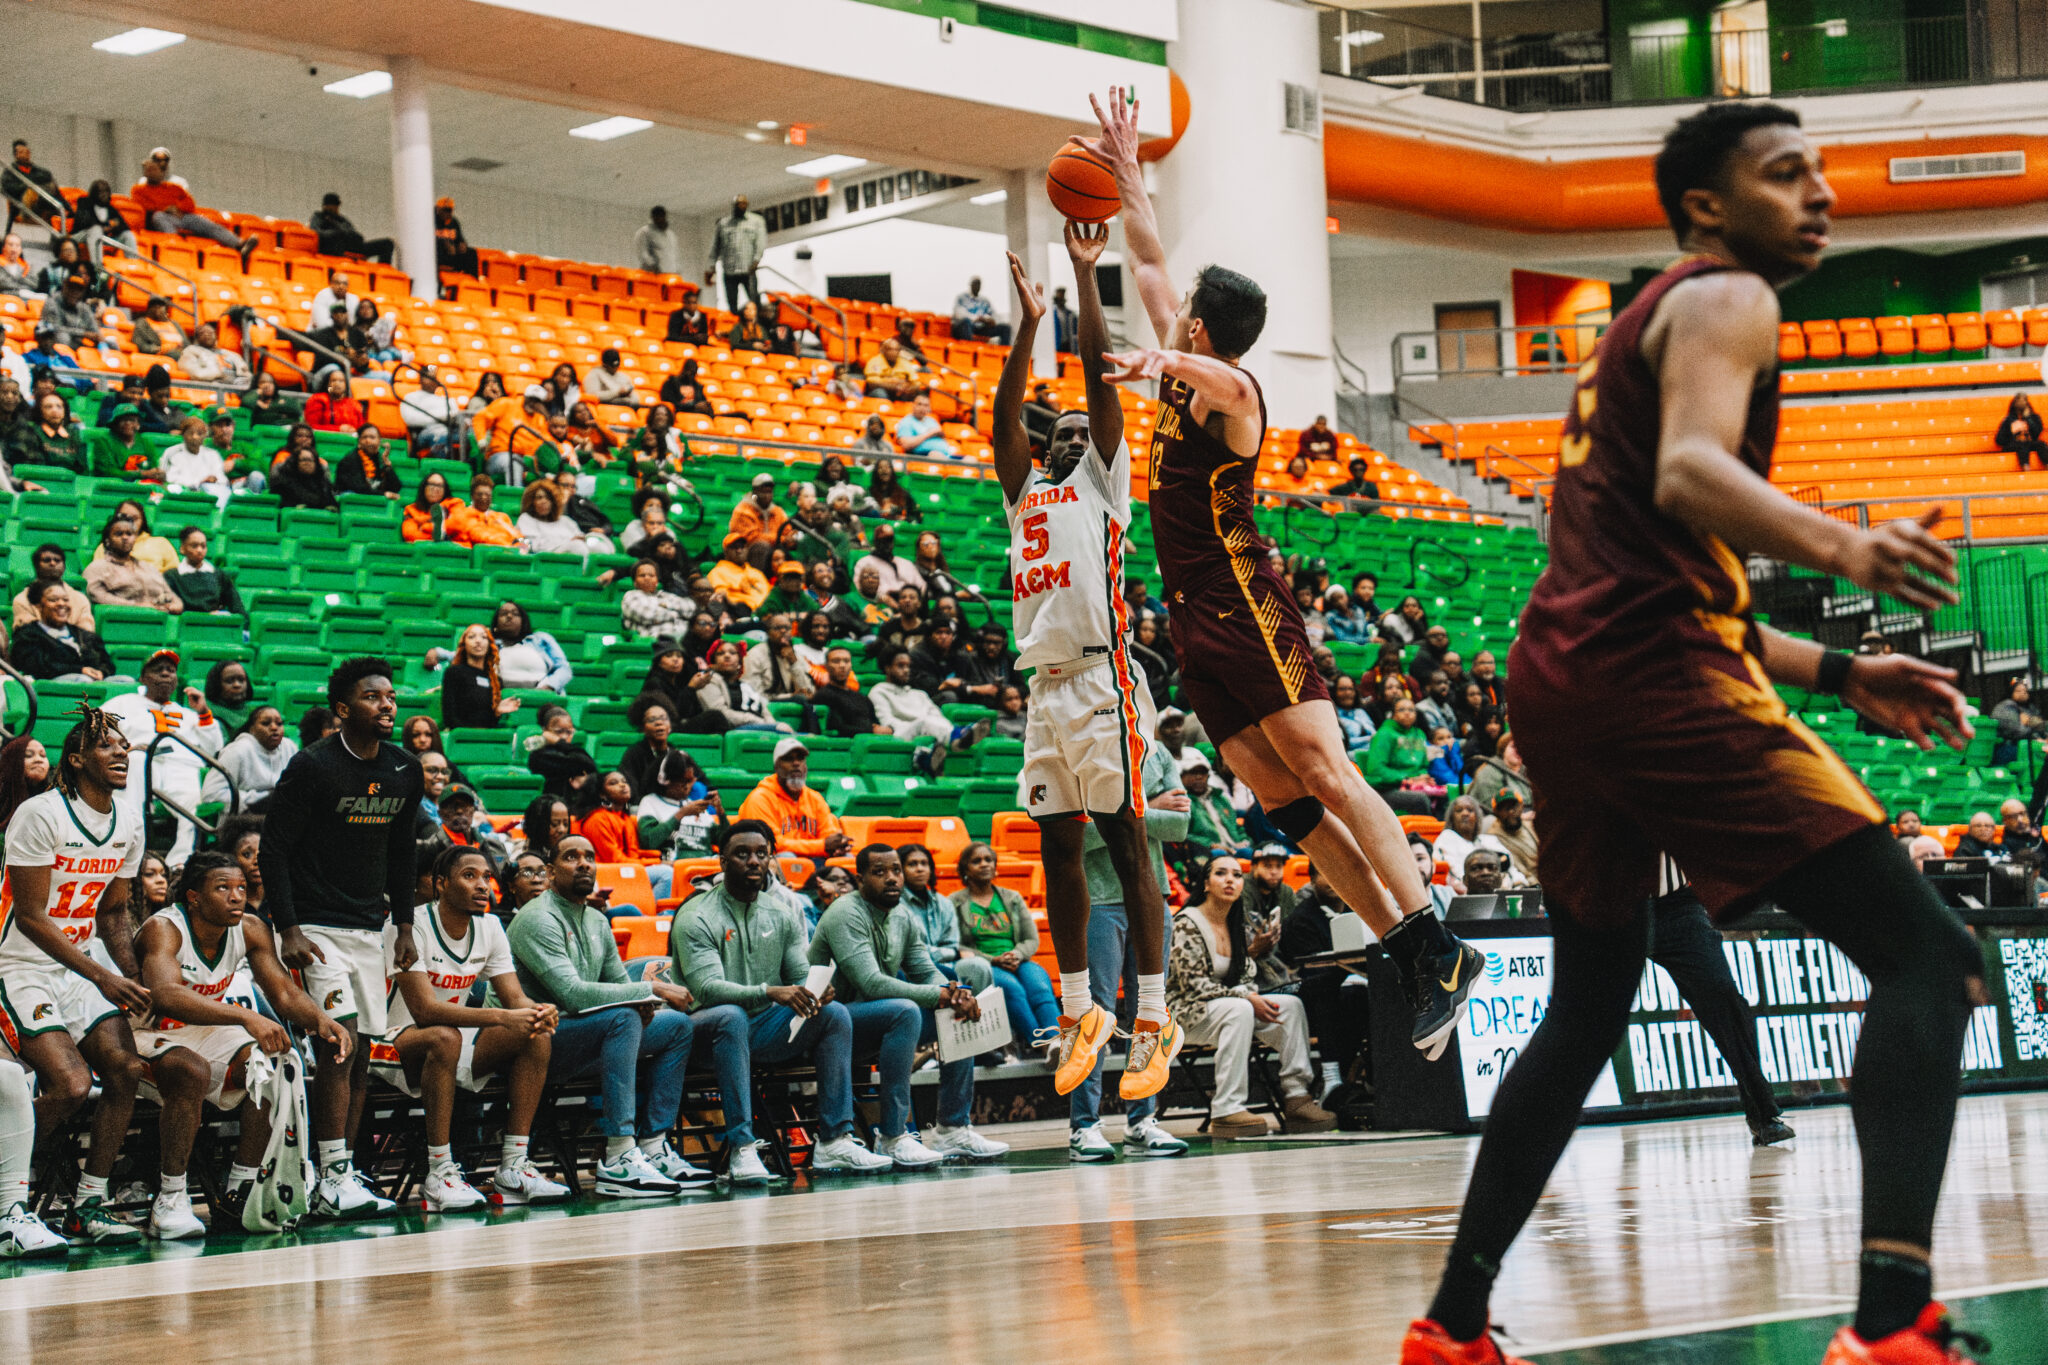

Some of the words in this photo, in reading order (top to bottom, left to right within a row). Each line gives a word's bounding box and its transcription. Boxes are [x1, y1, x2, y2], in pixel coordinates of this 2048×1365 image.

[1022, 512, 1049, 561] 5
[1013, 561, 1071, 602] A&M
[335, 797, 406, 814] FAMU
[48, 881, 106, 918] 12
[1509, 956, 1545, 977] AT&T
[1756, 939, 1809, 1006] THE
[1803, 938, 1872, 1004] FLOR
[1469, 995, 1552, 1037] DREA
[1756, 1011, 1866, 1083] ATHLETIC
[1960, 1005, 2003, 1070] DAY
[1477, 1059, 1494, 1076] in
